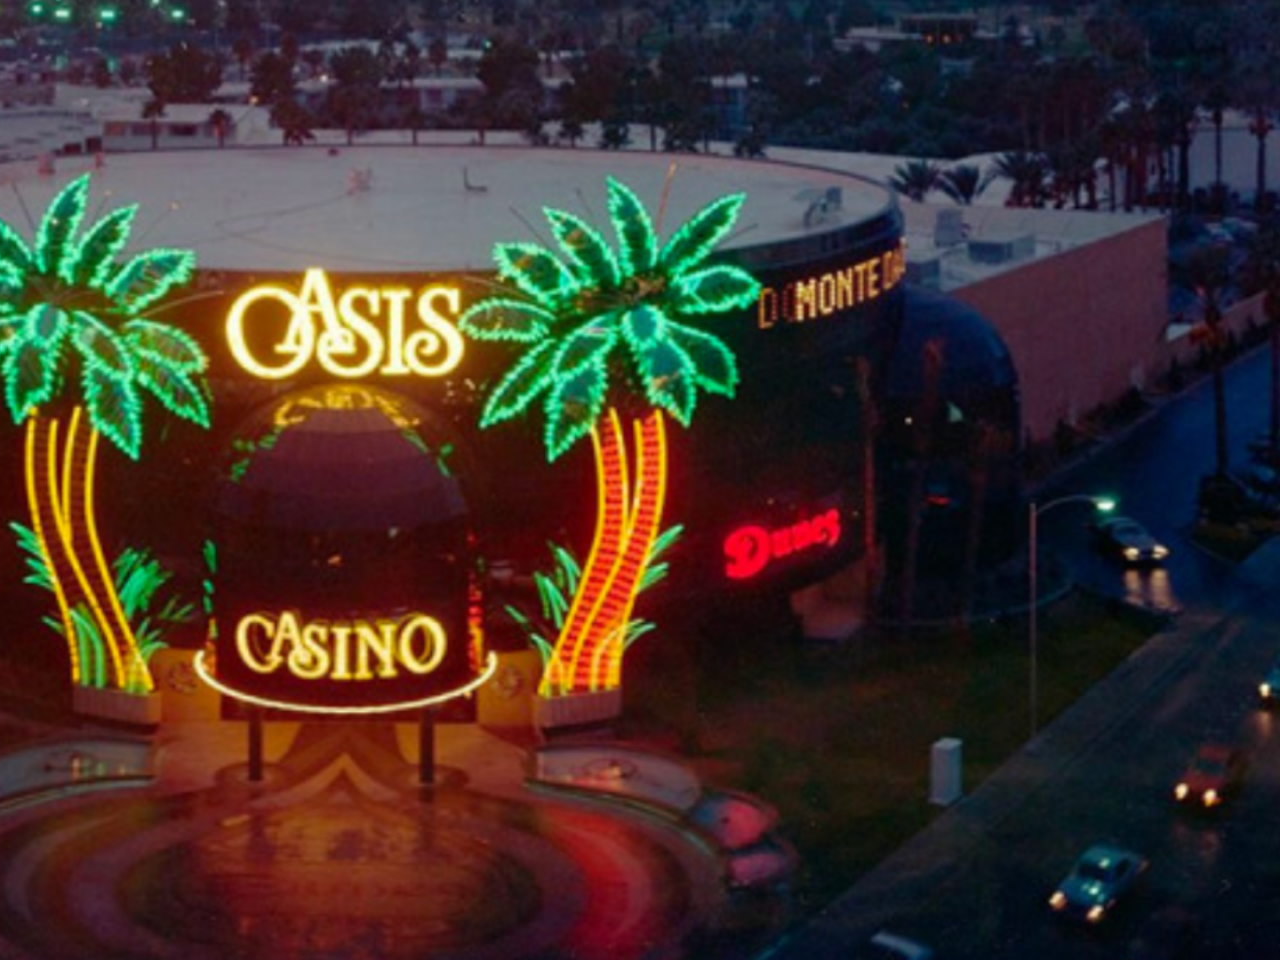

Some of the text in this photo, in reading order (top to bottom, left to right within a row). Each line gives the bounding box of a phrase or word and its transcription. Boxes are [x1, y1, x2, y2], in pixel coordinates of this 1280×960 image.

[225, 267, 466, 380] OASIS
[794, 256, 881, 322] MONTE
[723, 507, 840, 579] Dunes
[235, 609, 448, 681] CASINO
